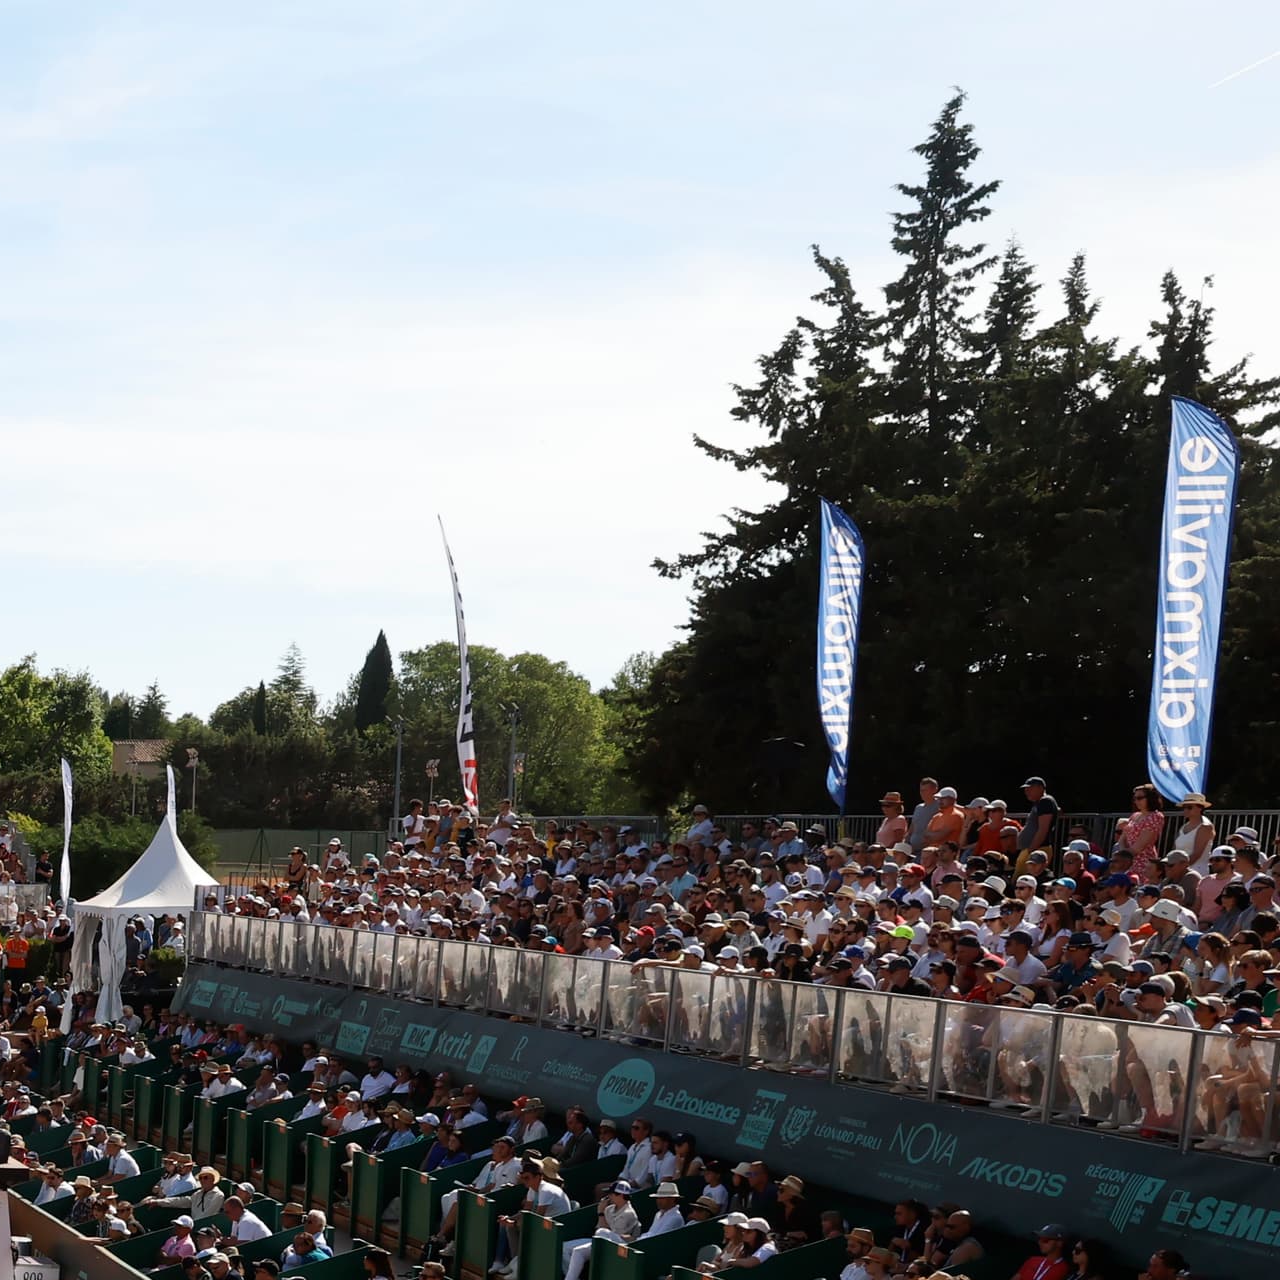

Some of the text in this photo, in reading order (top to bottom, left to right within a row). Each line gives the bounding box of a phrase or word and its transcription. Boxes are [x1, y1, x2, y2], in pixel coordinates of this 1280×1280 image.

[889, 1122, 958, 1167] NOVA
[1085, 1163, 1132, 1183] RÉGION
[1096, 1183, 1120, 1198] SUD
